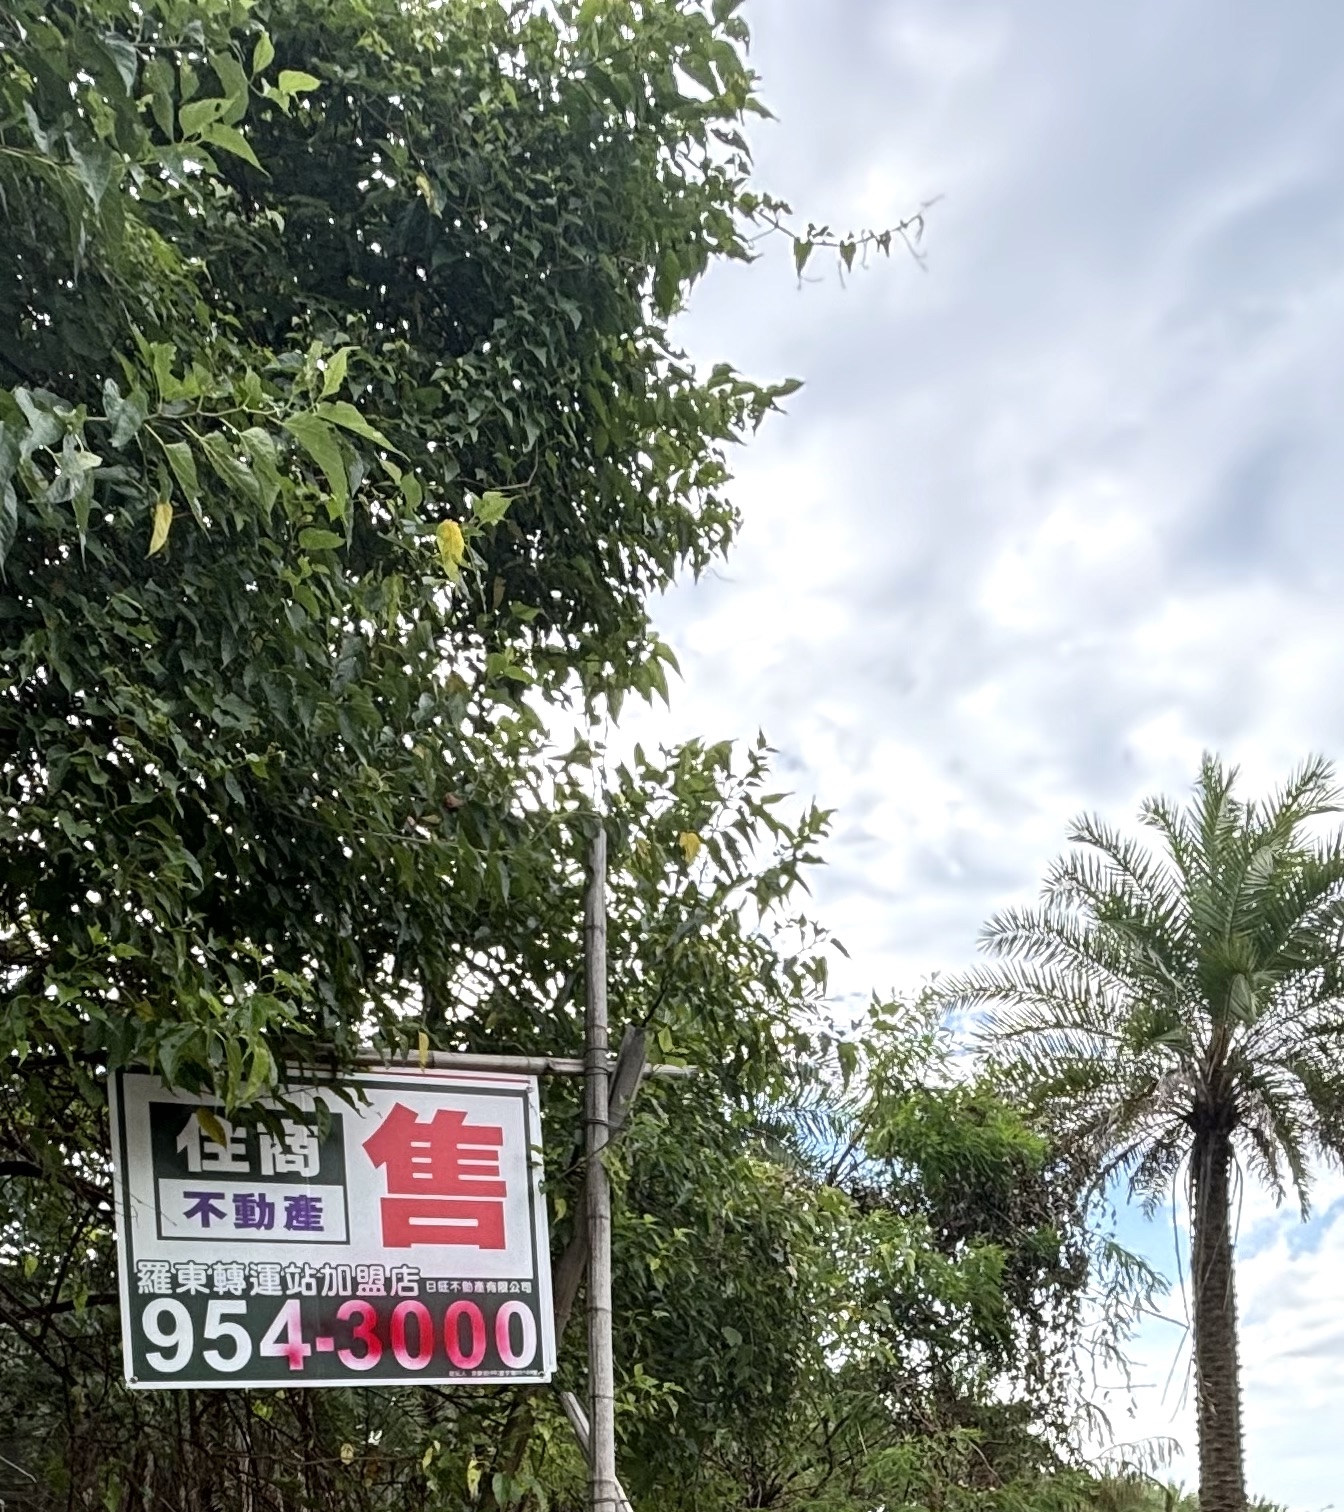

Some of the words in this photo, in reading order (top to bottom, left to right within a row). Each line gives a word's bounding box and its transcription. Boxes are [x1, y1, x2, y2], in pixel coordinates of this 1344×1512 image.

[176, 1113, 320, 1177] 住商
[362, 1102, 507, 1250] 售
[183, 1191, 324, 1232] 不動產
[137, 1261, 421, 1297] 羅東轉運站加盟店
[426, 1281, 532, 1293] 日旺不動產有限公司
[141, 1298, 537, 1373] 954-3000
